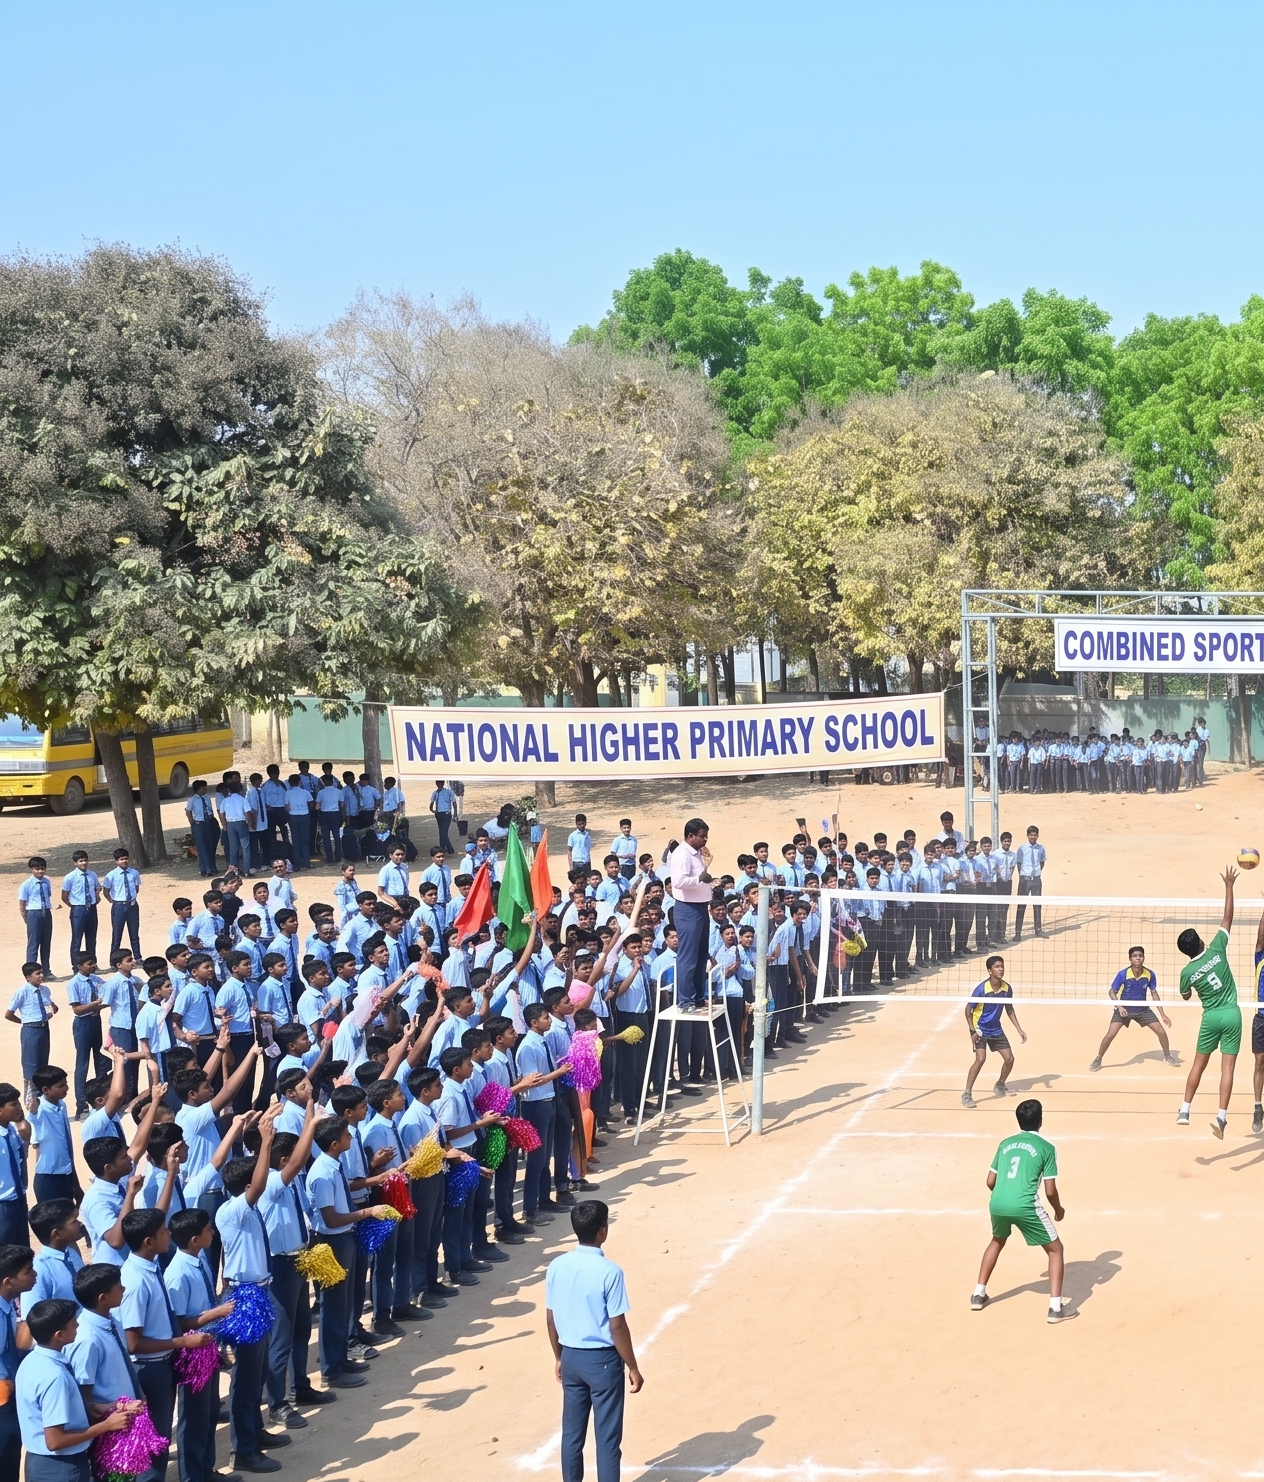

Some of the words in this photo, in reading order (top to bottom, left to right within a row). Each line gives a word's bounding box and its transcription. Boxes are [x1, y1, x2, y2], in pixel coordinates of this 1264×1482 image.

[1064, 630, 1185, 661] COMBINED
[406, 722, 558, 762] NATIONAL
[569, 723, 680, 762] HIGHER
[690, 717, 814, 759] PRIMARY
[825, 710, 934, 752] SCHOOL
[1007, 1156, 1021, 1179] 3
